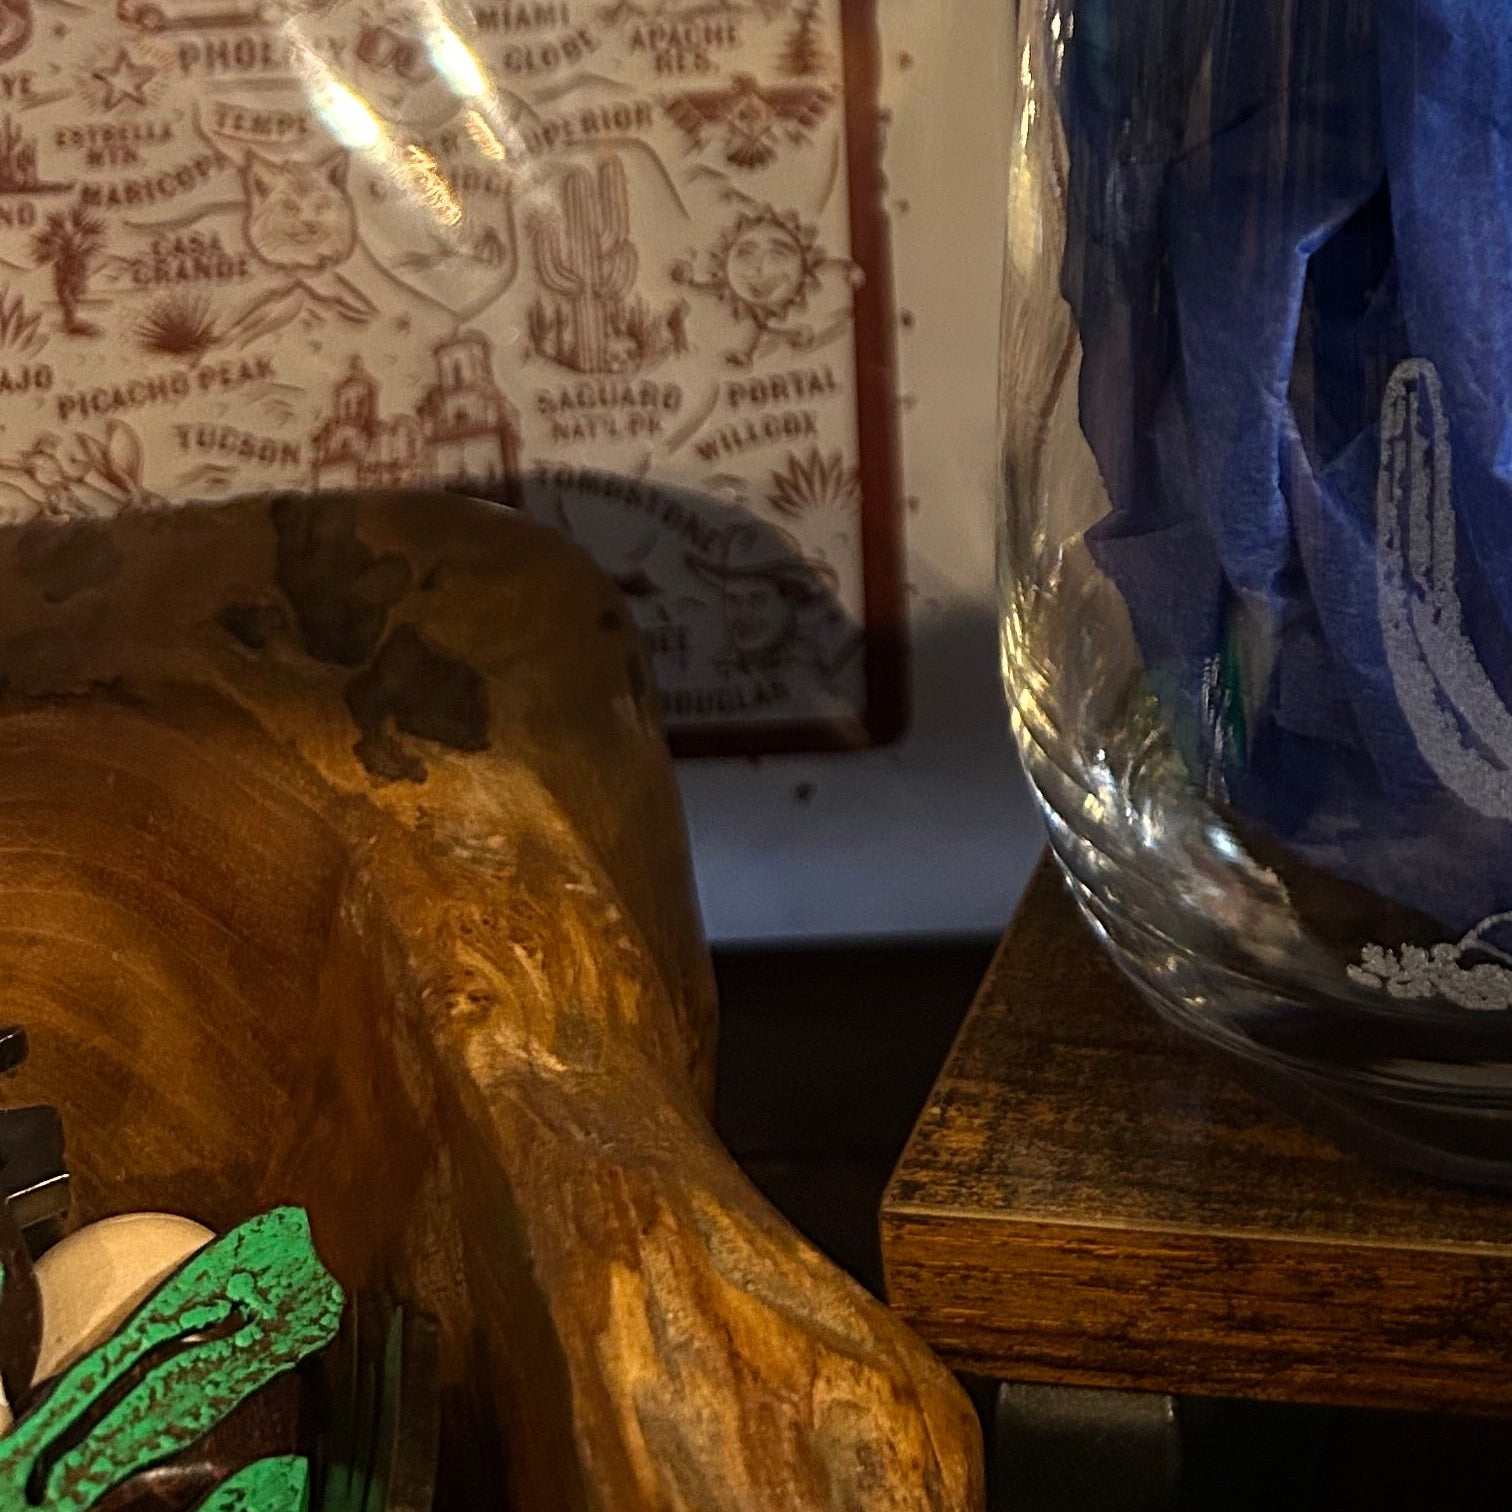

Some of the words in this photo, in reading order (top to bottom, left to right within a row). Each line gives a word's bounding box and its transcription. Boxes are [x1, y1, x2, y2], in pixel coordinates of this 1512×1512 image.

[474, 2, 570, 33] MIAMI
[629, 20, 738, 53] APACHE
[502, 27, 598, 76] GLOBE
[130, 253, 250, 288] GRANDE
[56, 370, 190, 423] PICACHO
[197, 352, 276, 391] PEAK
[536, 379, 683, 415] SAGUARO
[727, 368, 836, 410] PORTAL
[174, 421, 302, 468] TUCSON
